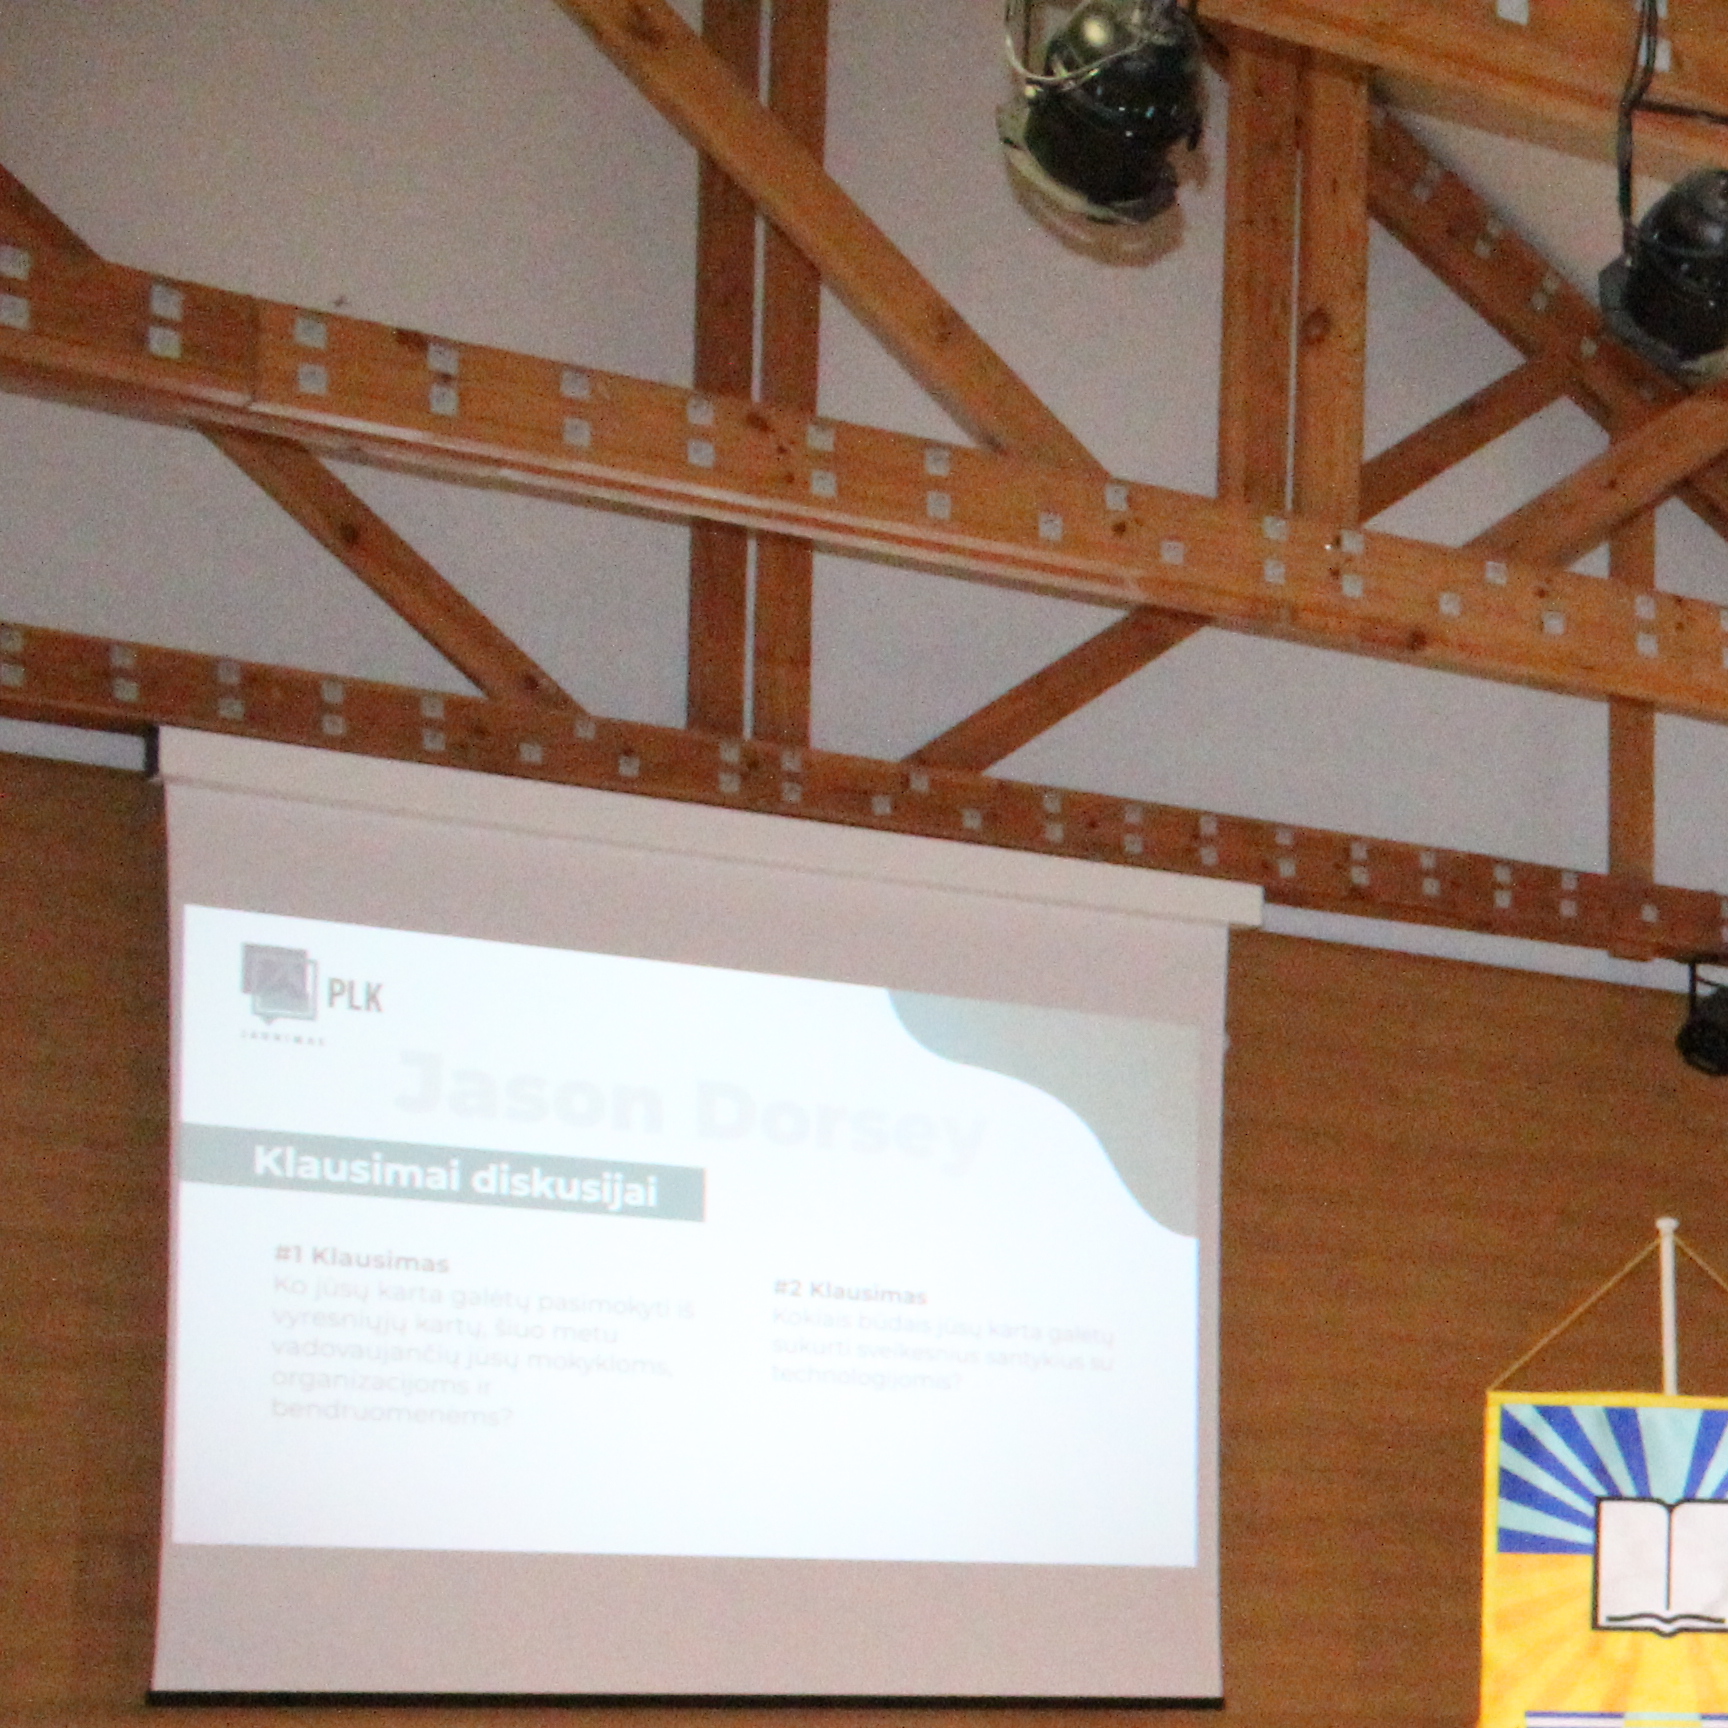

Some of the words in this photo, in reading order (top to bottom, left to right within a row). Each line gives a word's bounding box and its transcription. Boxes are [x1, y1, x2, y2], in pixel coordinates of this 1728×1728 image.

[327, 977, 383, 1012] PLK
[393, 1050, 663, 1135] Jason
[697, 1079, 987, 1180] Dorsey
[253, 1144, 461, 1193] Klausimai
[471, 1162, 659, 1212] diskusijai
[275, 1243, 302, 1265] #1
[311, 1245, 451, 1275] Klausimas
[274, 1276, 308, 1296] Ko
[774, 1279, 802, 1298] #2
[809, 1281, 929, 1305] Klausimas
